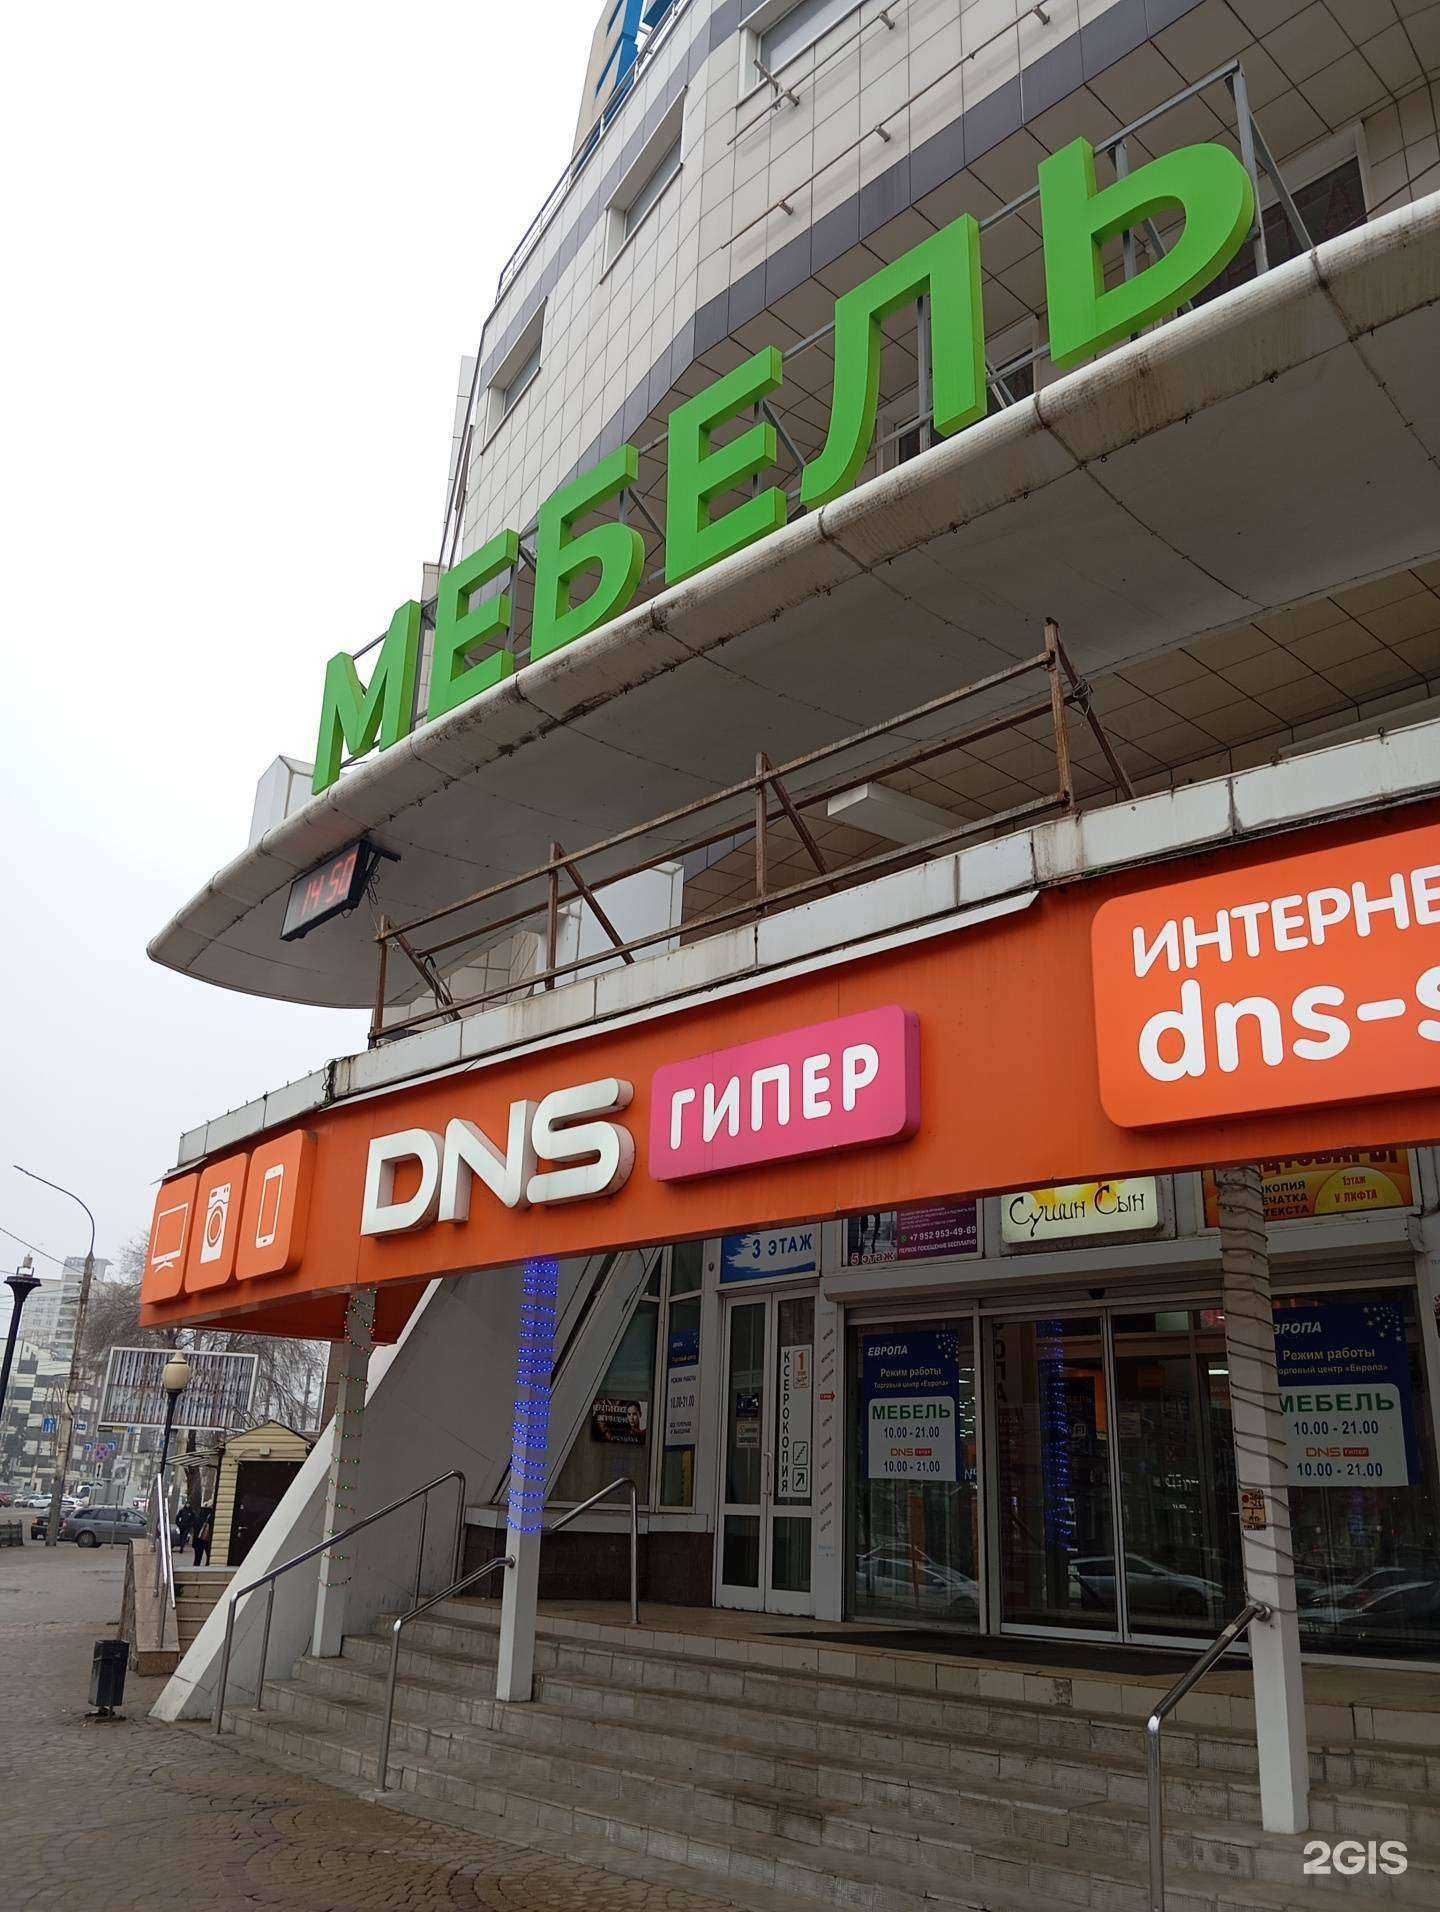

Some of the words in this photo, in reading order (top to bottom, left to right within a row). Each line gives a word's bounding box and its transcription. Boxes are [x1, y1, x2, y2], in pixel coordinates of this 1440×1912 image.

[311, 136, 1255, 796] МЕБЕЛЬ
[670, 1043, 880, 1151] ГИПЕР
[360, 1078, 635, 1237] DNS
[1344, 1189, 1377, 1202] ЛИФТА
[1010, 1196, 1085, 1237] Сушин
[1095, 1185, 1144, 1214] Сын
[919, 1232, 934, 1240] 952
[751, 1239, 760, 1258] 3
[768, 1233, 812, 1256] ЭТАЖ
[851, 1252, 860, 1265] 5
[862, 1251, 895, 1264] этаж
[868, 1345, 909, 1356] ЕВРОПА
[1283, 1350, 1323, 1360] Режим
[1327, 1348, 1375, 1361] работы
[910, 1367, 943, 1379] работы
[872, 1404, 950, 1420] МЕБЕЛЬ
[884, 1427, 907, 1438] 10.00
[915, 1426, 939, 1438] 21.00
[1293, 1421, 1329, 1435] 10.00
[1342, 1421, 1379, 1434] 21.00
[891, 1448, 914, 1456] DNS
[1306, 1447, 1341, 1457] DNS
[884, 1461, 907, 1472] 10.00
[917, 1461, 940, 1472] 21.00
[1297, 1463, 1332, 1476] 10.00
[1347, 1463, 1383, 1476] 21.00
